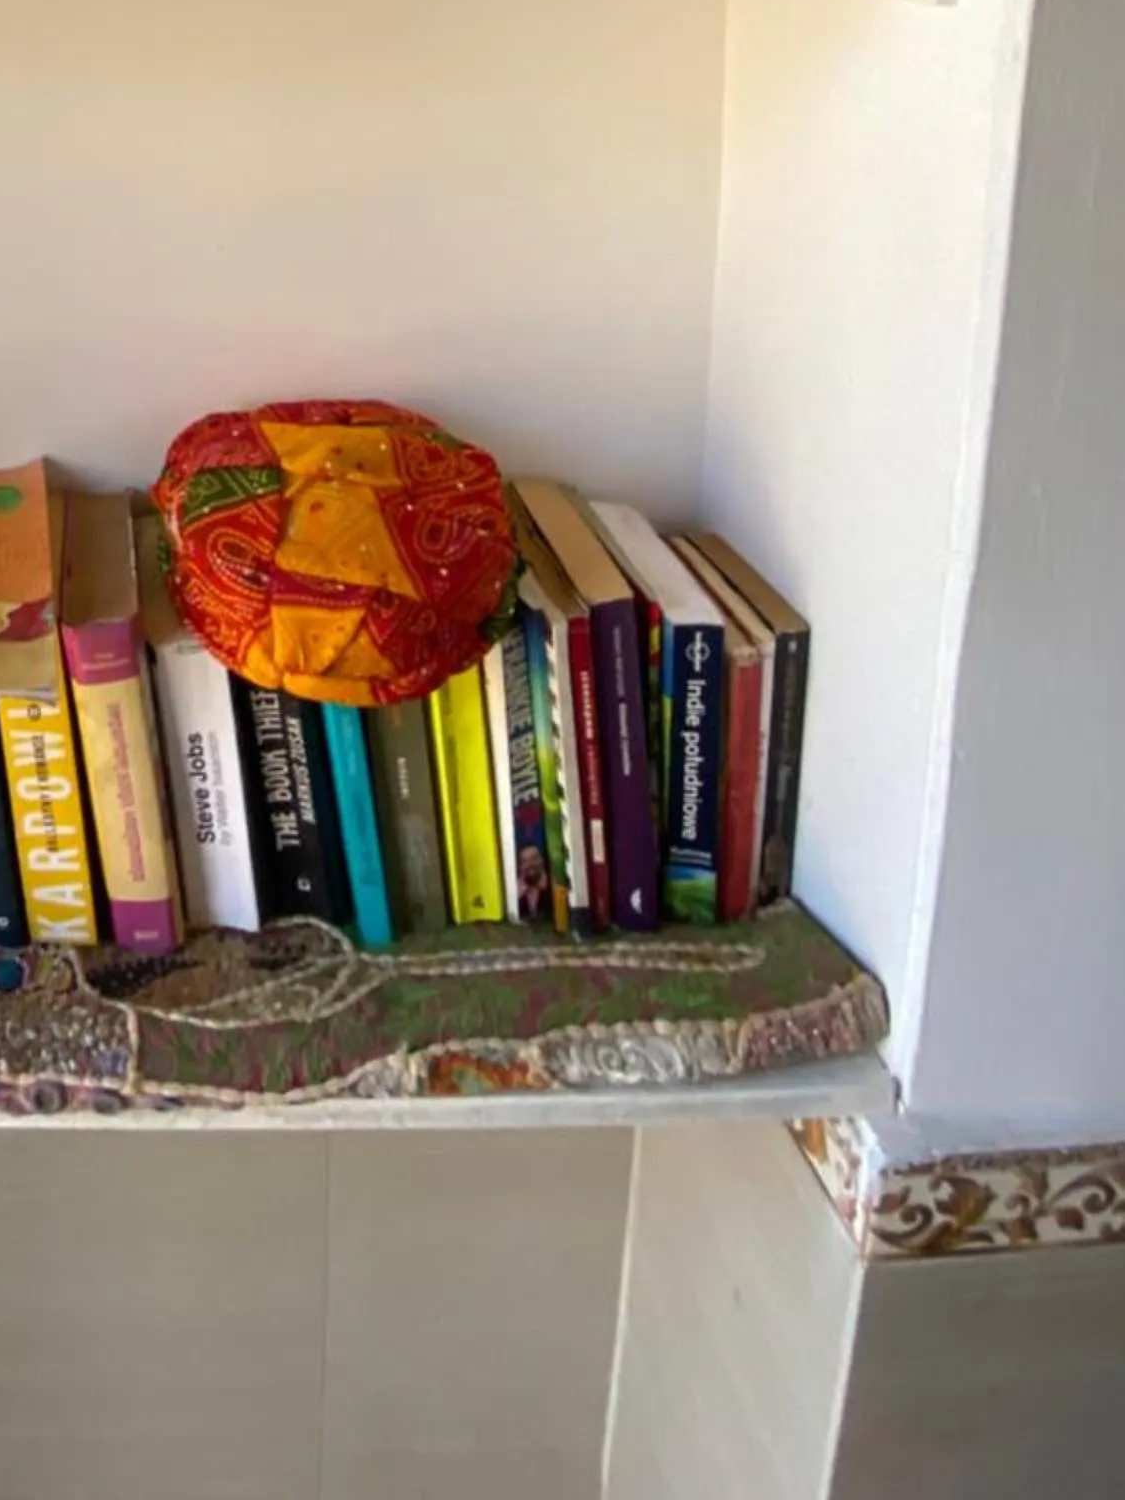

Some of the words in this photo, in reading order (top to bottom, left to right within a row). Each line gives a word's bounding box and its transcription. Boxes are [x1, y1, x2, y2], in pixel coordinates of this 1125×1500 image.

[686, 679, 707, 727] Indie
[186, 731, 208, 783] Jobs
[260, 749, 294, 804] BOOK
[7, 704, 91, 940] KARPOWI
[195, 787, 216, 845] Steve
[270, 811, 301, 851] THE
